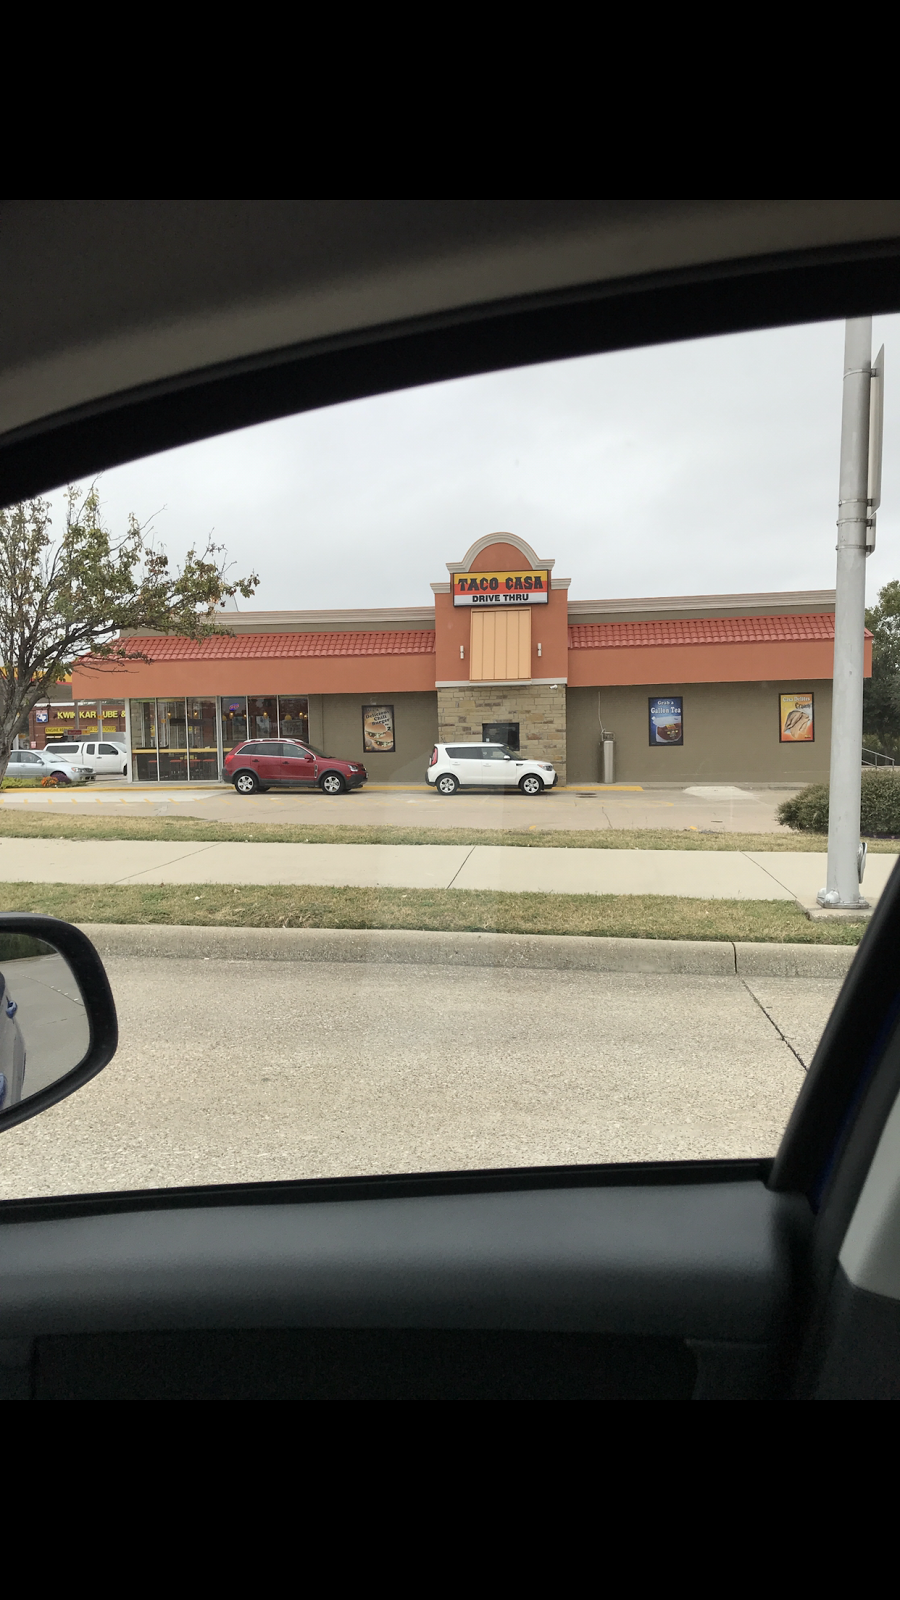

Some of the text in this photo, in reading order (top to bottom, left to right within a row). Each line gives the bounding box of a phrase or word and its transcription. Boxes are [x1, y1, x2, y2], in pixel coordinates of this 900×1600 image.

[458, 576, 543, 591] TACO CASA
[503, 593, 529, 601] THRU
